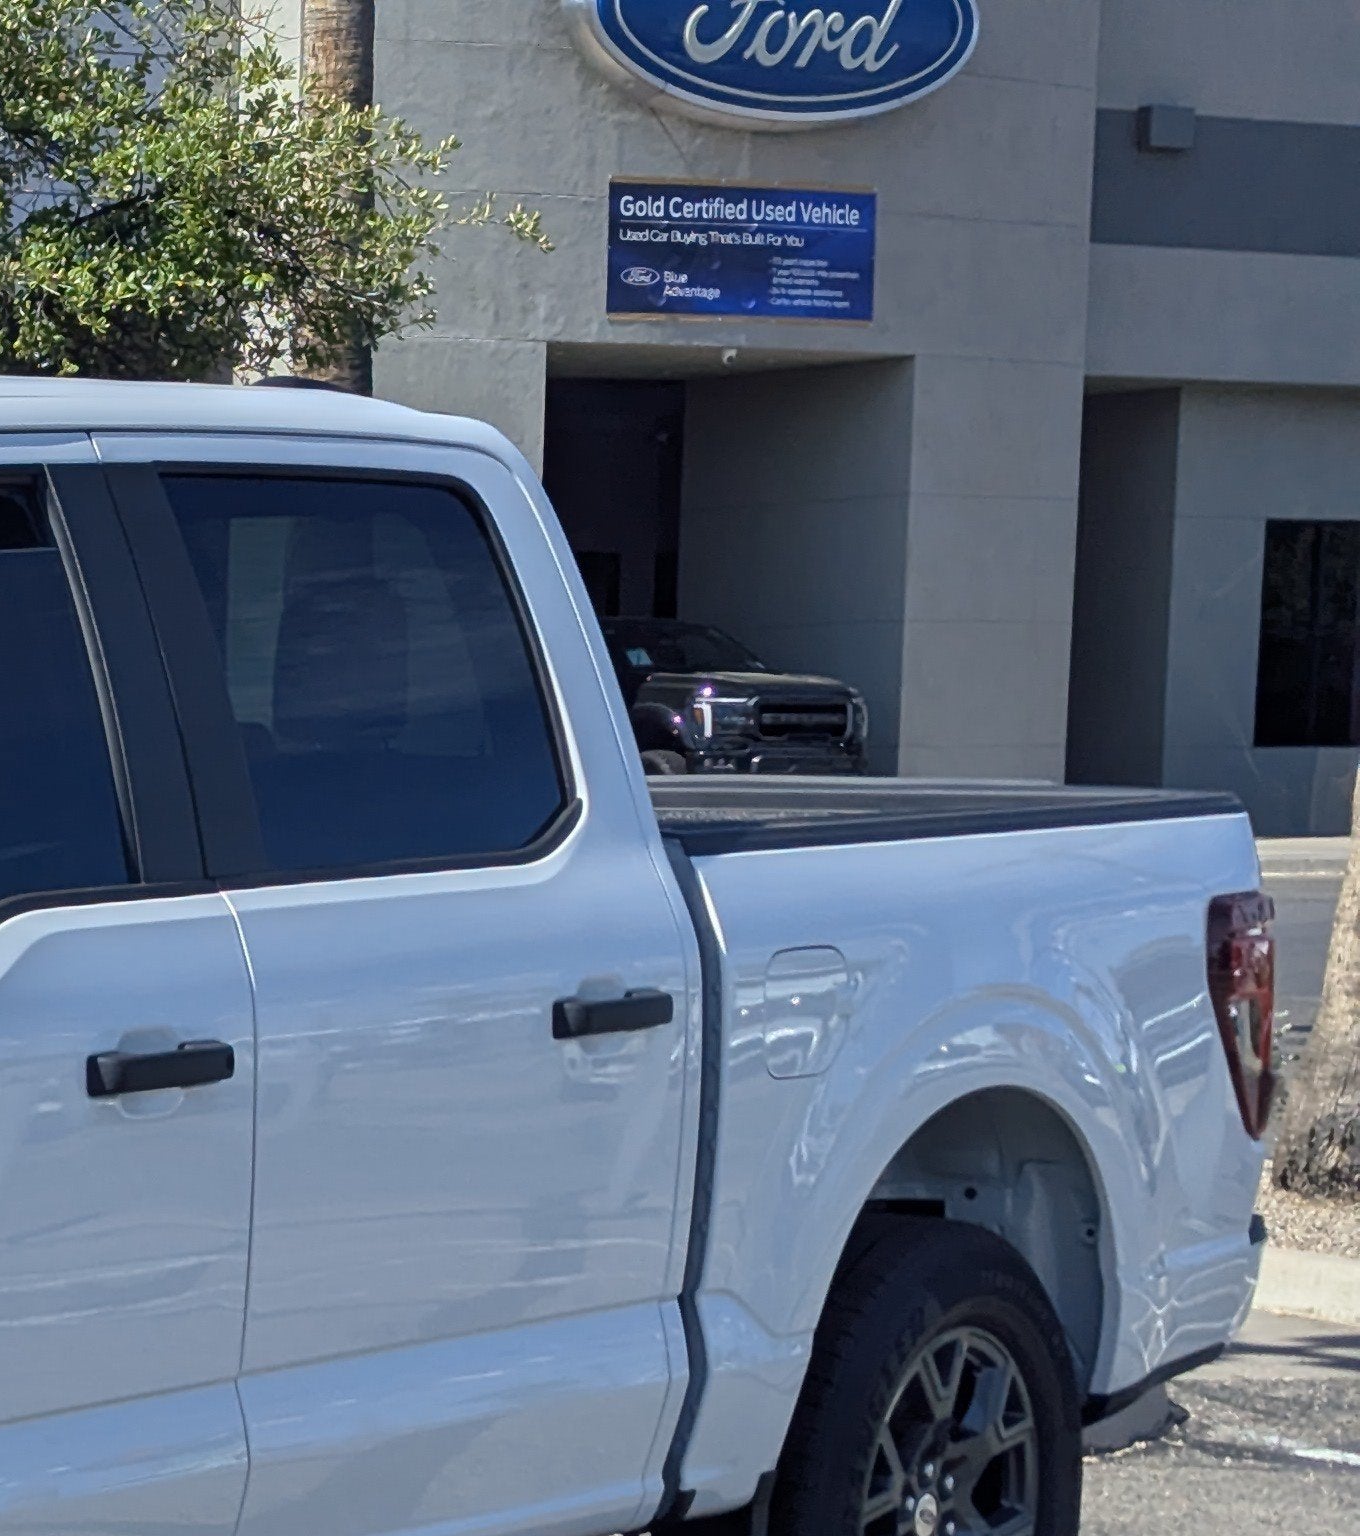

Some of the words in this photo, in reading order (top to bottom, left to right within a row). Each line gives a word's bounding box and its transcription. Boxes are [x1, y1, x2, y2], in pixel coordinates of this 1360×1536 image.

[619, 195, 665, 217] Gold
[668, 197, 747, 220] Certified
[751, 199, 796, 222] Used
[799, 202, 860, 226] Vehicle
[619, 229, 649, 242] Used
[650, 230, 669, 242] Car
[670, 230, 708, 245] Buying
[708, 231, 741, 245] That's
[742, 233, 766, 245] Built
[766, 233, 783, 246] For
[783, 234, 805, 247] You
[663, 270, 689, 284] Blue
[663, 284, 721, 300] Advantage
